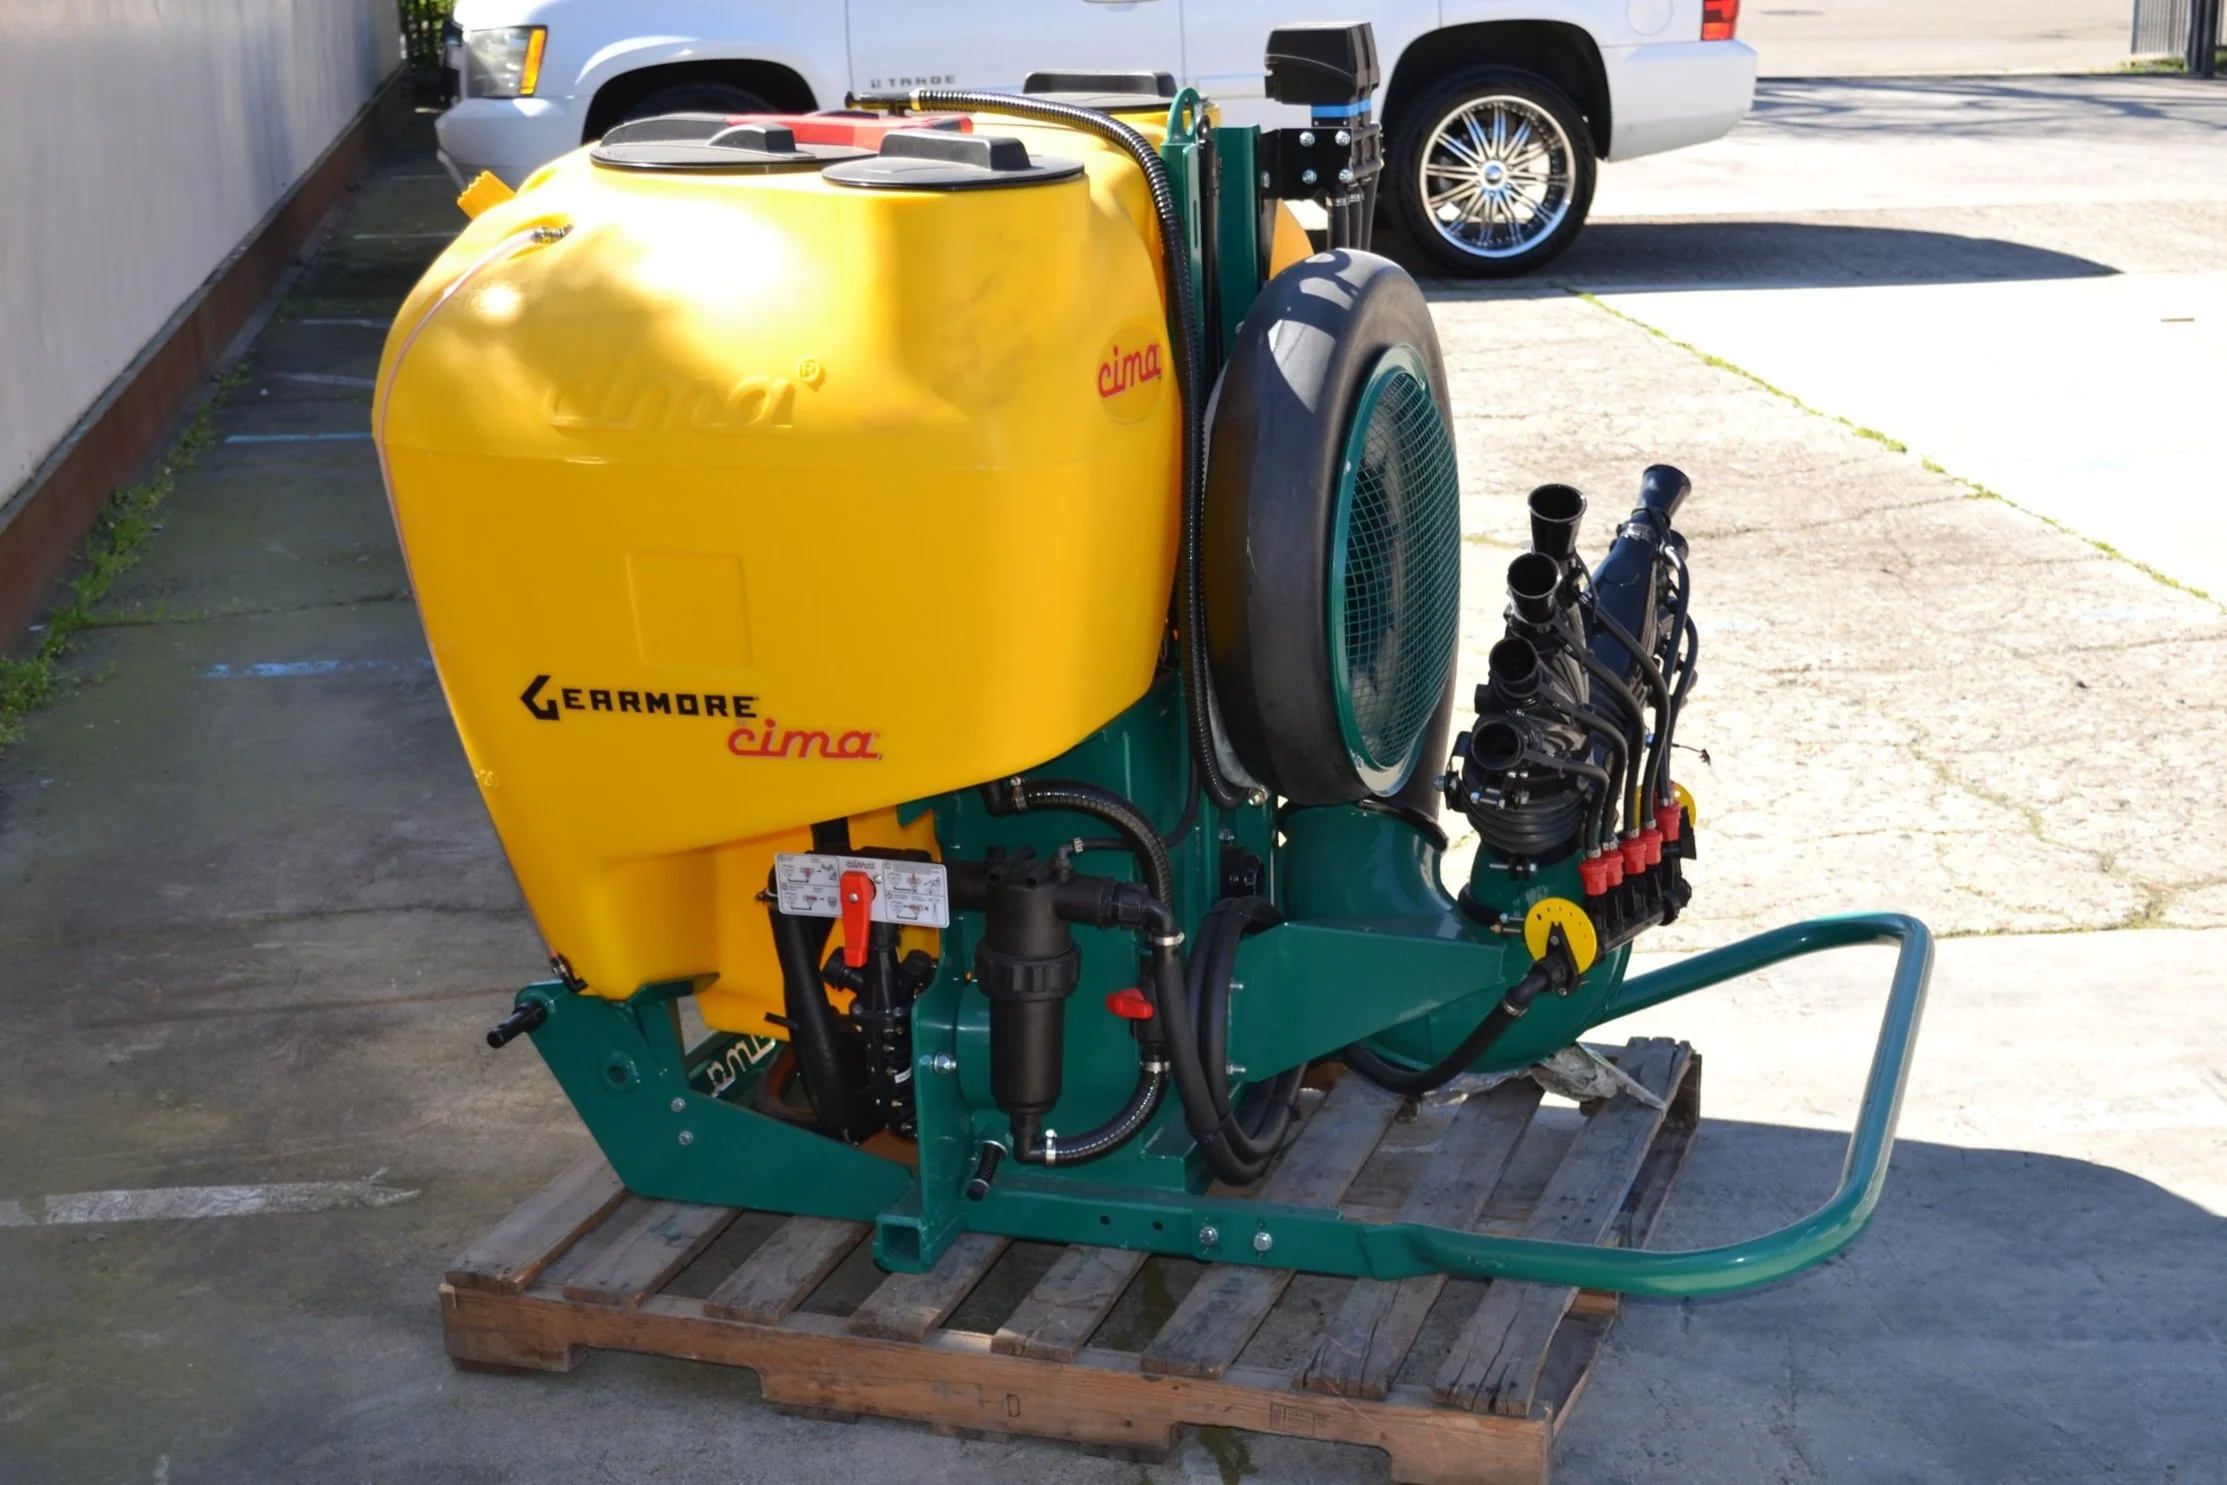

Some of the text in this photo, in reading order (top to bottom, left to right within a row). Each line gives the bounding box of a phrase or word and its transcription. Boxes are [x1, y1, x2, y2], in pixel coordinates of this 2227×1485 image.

[888, 74, 957, 88] TAHOE
[1098, 344, 1161, 398] cima
[520, 675, 758, 720] GEARMORE
[727, 718, 883, 760] cima
